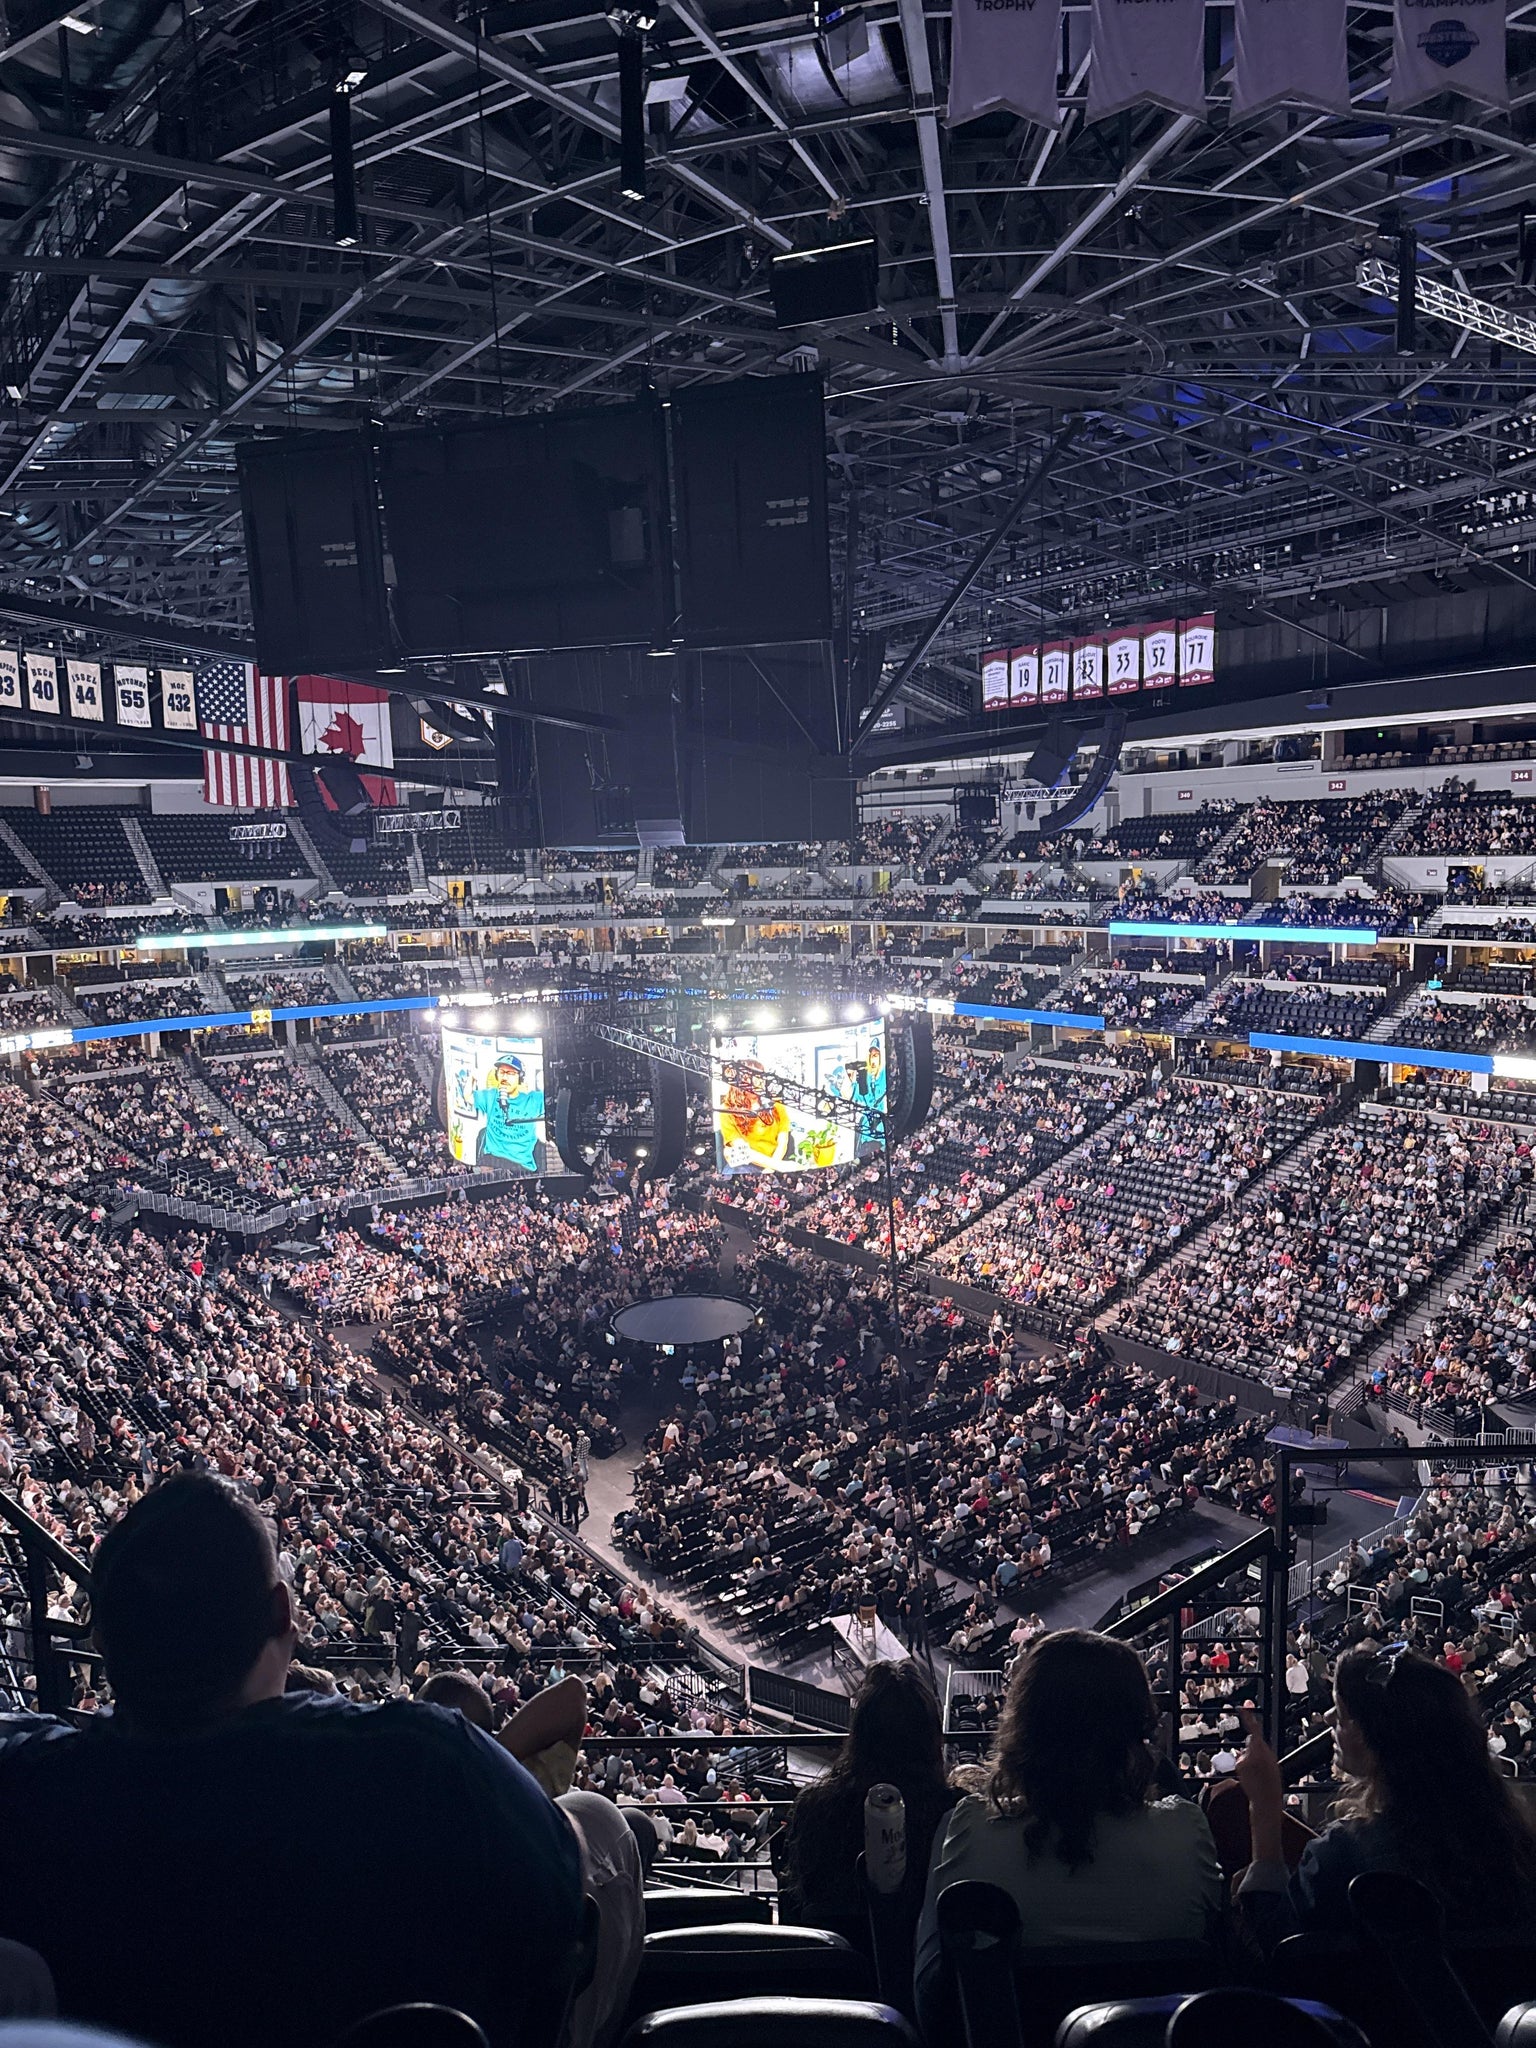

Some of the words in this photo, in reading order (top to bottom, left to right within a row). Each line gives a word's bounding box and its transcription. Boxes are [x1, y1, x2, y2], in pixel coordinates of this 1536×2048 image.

[975, 0, 1037, 11] TROPHY
[1405, 0, 1494, 8] CHAMPION
[1153, 647, 1165, 668] 52
[1189, 642, 1203, 665] 77
[1117, 652, 1130, 675] 33
[71, 673, 97, 685] ISSEL
[1019, 668, 1030, 688] 19
[1048, 665, 1059, 684] 21
[32, 679, 54, 701] 40
[75, 684, 96, 706] 44
[170, 682, 186, 691] MOE
[120, 689, 146, 709] 55
[167, 692, 191, 713] 432
[1514, 772, 1529, 780] 344
[1179, 791, 1191, 799] 340
[1331, 782, 1344, 790] 342
